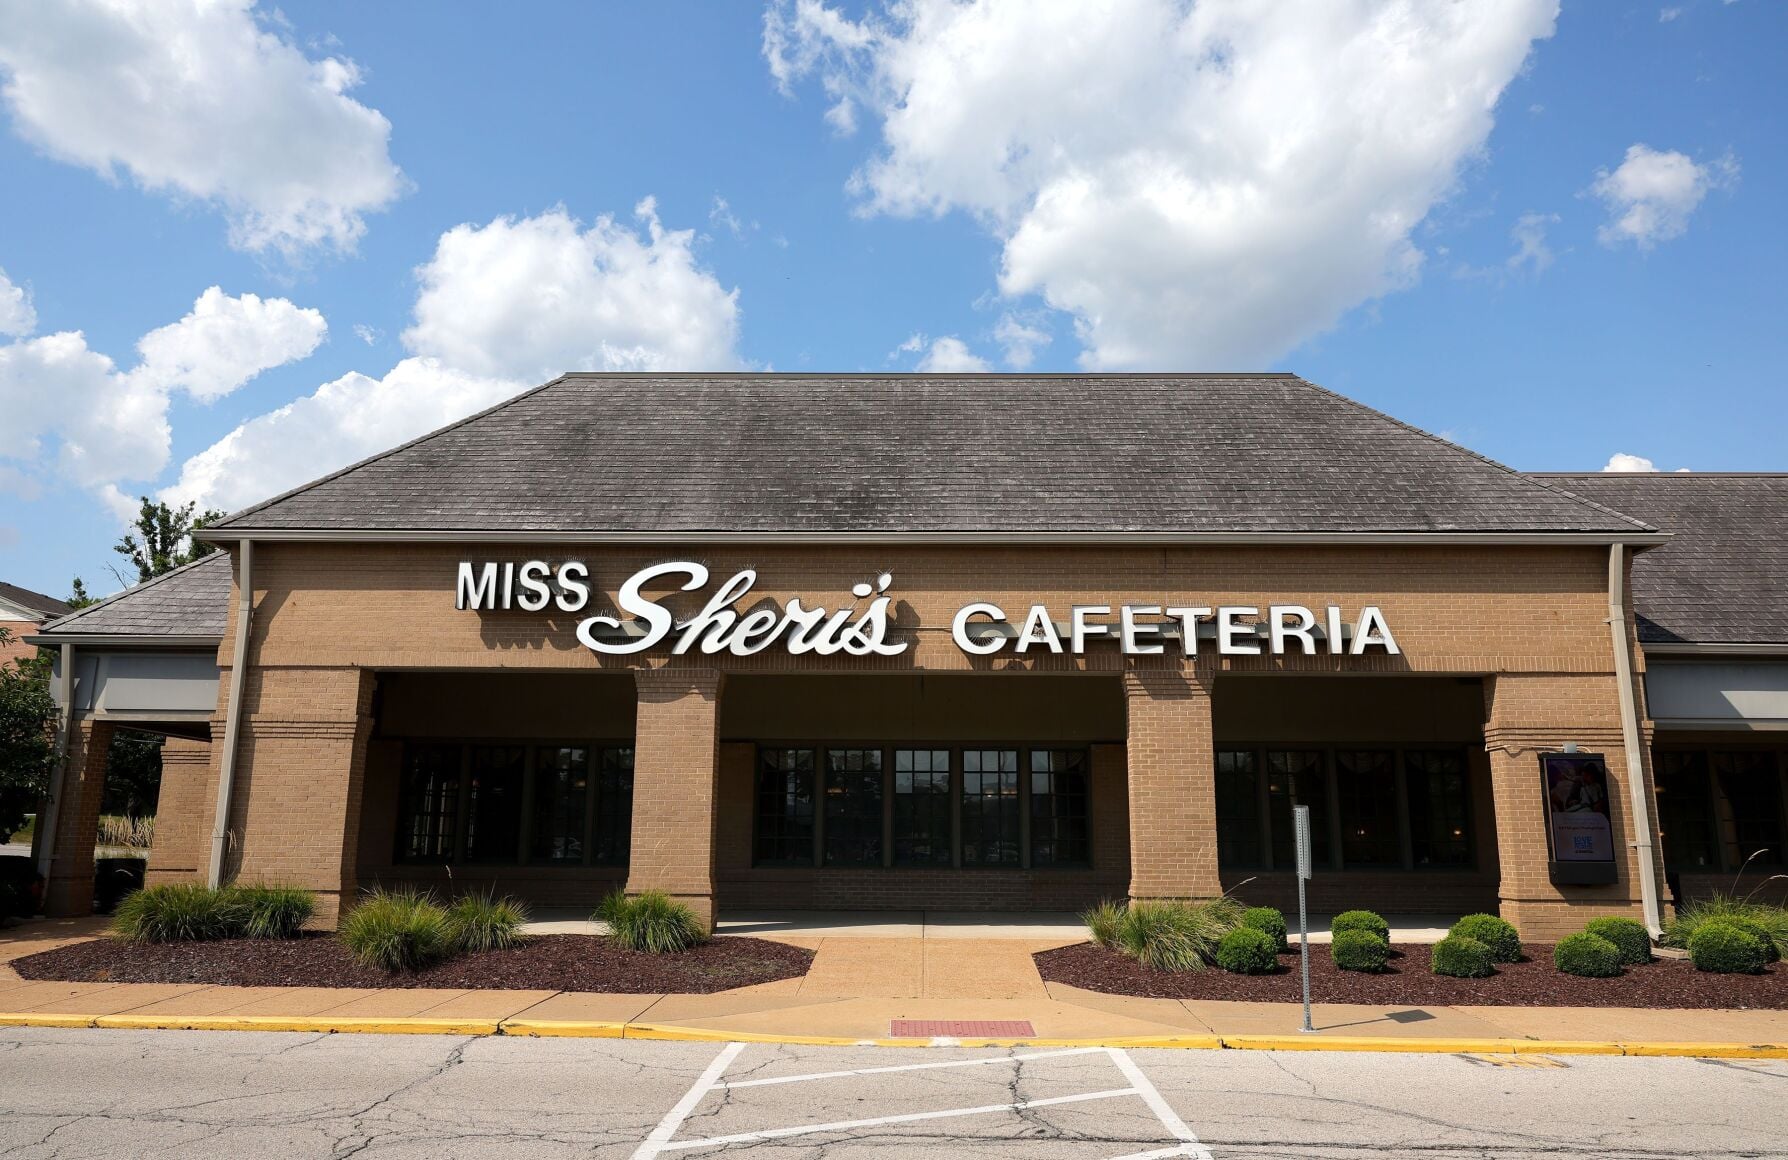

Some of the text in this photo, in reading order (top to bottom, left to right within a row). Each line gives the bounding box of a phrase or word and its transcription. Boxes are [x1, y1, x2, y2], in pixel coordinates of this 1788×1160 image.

[455, 561, 1400, 656] MISS Sheri's CAFETERIA
